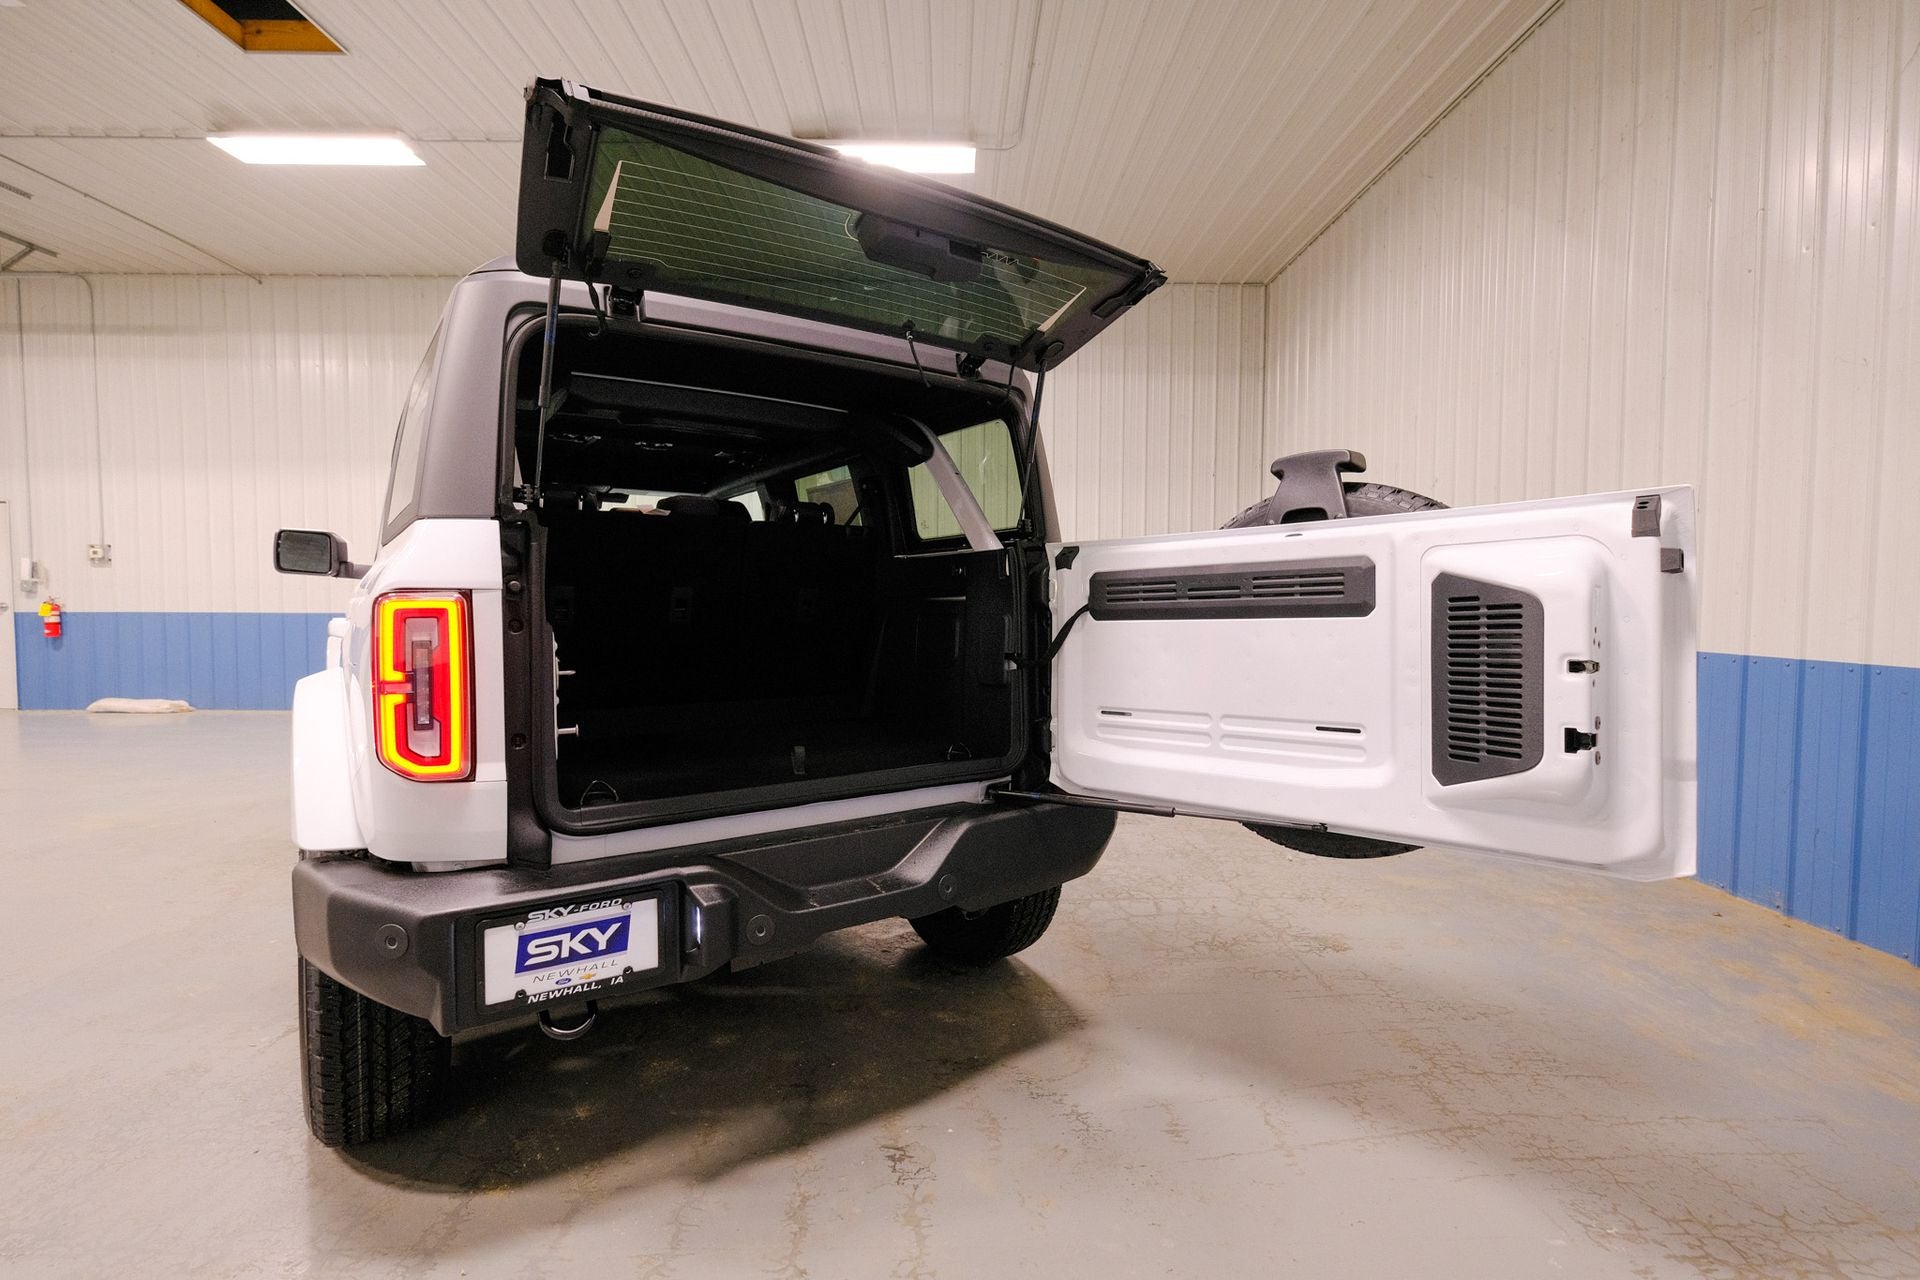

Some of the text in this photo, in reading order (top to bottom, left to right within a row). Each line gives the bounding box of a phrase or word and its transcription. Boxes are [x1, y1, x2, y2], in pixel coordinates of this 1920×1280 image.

[527, 898, 623, 922] SKY-FORD
[523, 922, 622, 967] SKY
[532, 959, 618, 984] NEWHALL
[610, 975, 624, 986] IA
